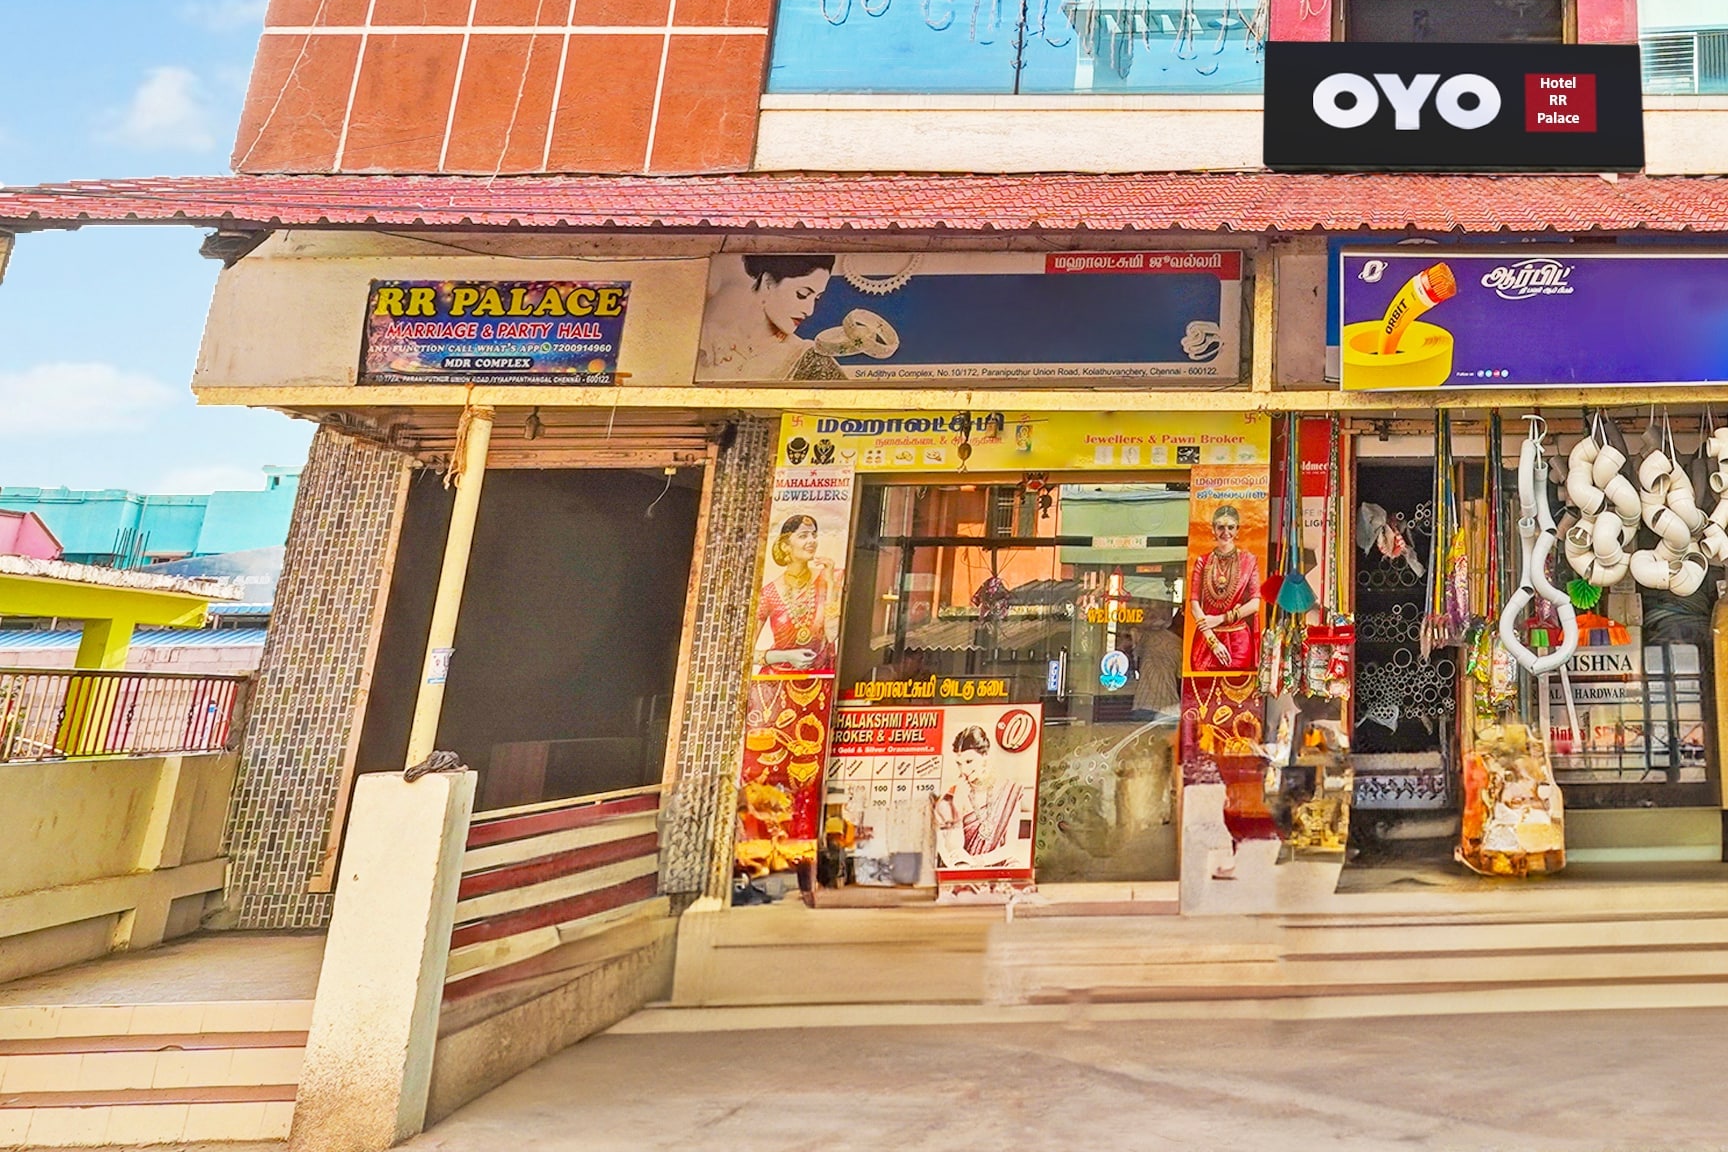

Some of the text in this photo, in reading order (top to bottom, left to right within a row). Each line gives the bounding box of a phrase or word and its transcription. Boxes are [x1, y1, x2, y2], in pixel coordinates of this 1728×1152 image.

[1540, 77, 1577, 89] Hotel
[1312, 73, 1501, 130] OYO
[1549, 95, 1568, 106] RR
[1537, 112, 1580, 124] Palace
[1055, 254, 1144, 272] மஹாலட்சுமி
[373, 286, 624, 317] RR PALACE
[1385, 298, 1408, 335] ORBIT
[385, 322, 602, 339] MARRIAGE & PARTY HALL
[392, 344, 446, 353] FUNCTION
[448, 344, 473, 353] CALL
[520, 344, 540, 353] APP
[444, 358, 531, 368] MDR COMPLEX
[855, 369, 866, 377] Sri
[868, 369, 896, 380] Adithya
[898, 369, 935, 379] Complex,
[981, 368, 1030, 378] Paraniputhur
[1033, 368, 1055, 376] Union
[1059, 368, 1081, 376] Road,
[1150, 367, 1181, 376] Chennai
[1084, 434, 1246, 444] Jewellers & Pawn Broker
[775, 477, 850, 488] MAHALAKSHMI
[774, 489, 849, 501] JEWELLERS
[1087, 608, 1144, 623] WELCOME
[940, 678, 976, 700] அடகு
[977, 679, 1008, 697] கடை
[836, 712, 938, 728] HALAKSHMI PAWN
[833, 730, 926, 743] ROKER & JEWEL
